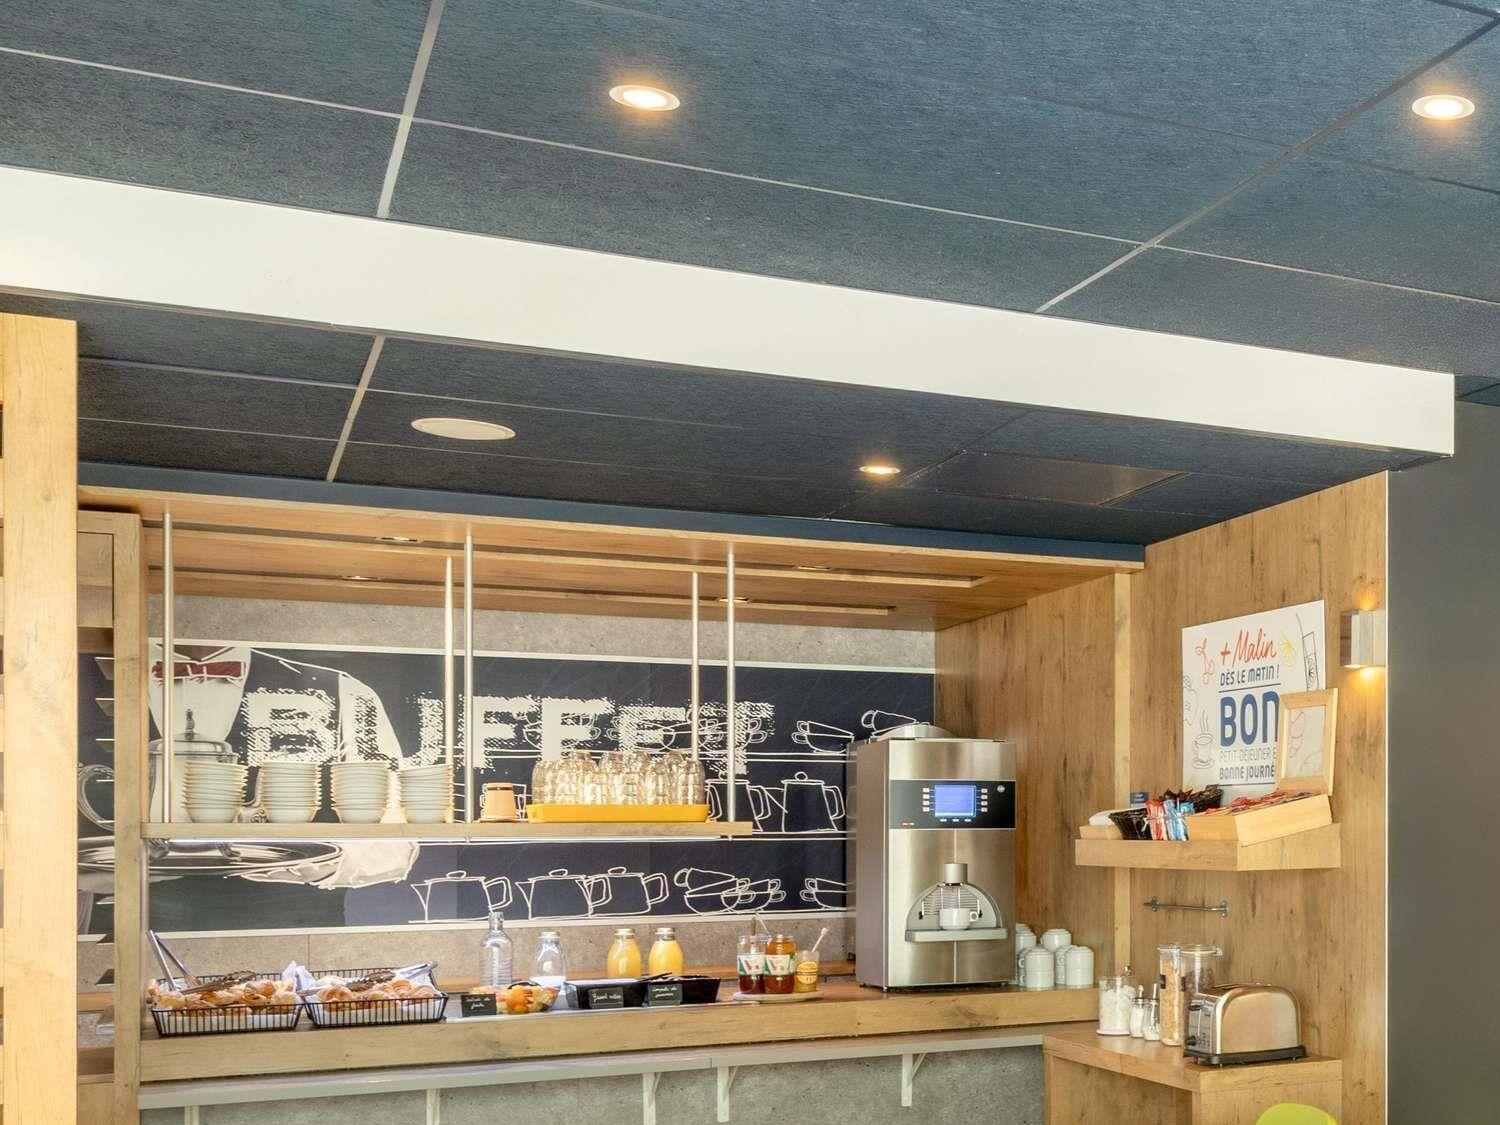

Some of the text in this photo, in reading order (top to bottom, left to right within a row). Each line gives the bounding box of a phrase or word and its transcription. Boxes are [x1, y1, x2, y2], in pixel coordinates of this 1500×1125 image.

[1232, 627, 1277, 669] Malin
[1220, 669, 1235, 686] DÈS
[1237, 670, 1246, 684] LE
[1248, 665, 1275, 682] MATIN
[240, 687, 775, 774] BUFFET
[1220, 690, 1280, 747] BON
[1219, 761, 1275, 781] BONNE JOURNÉ
